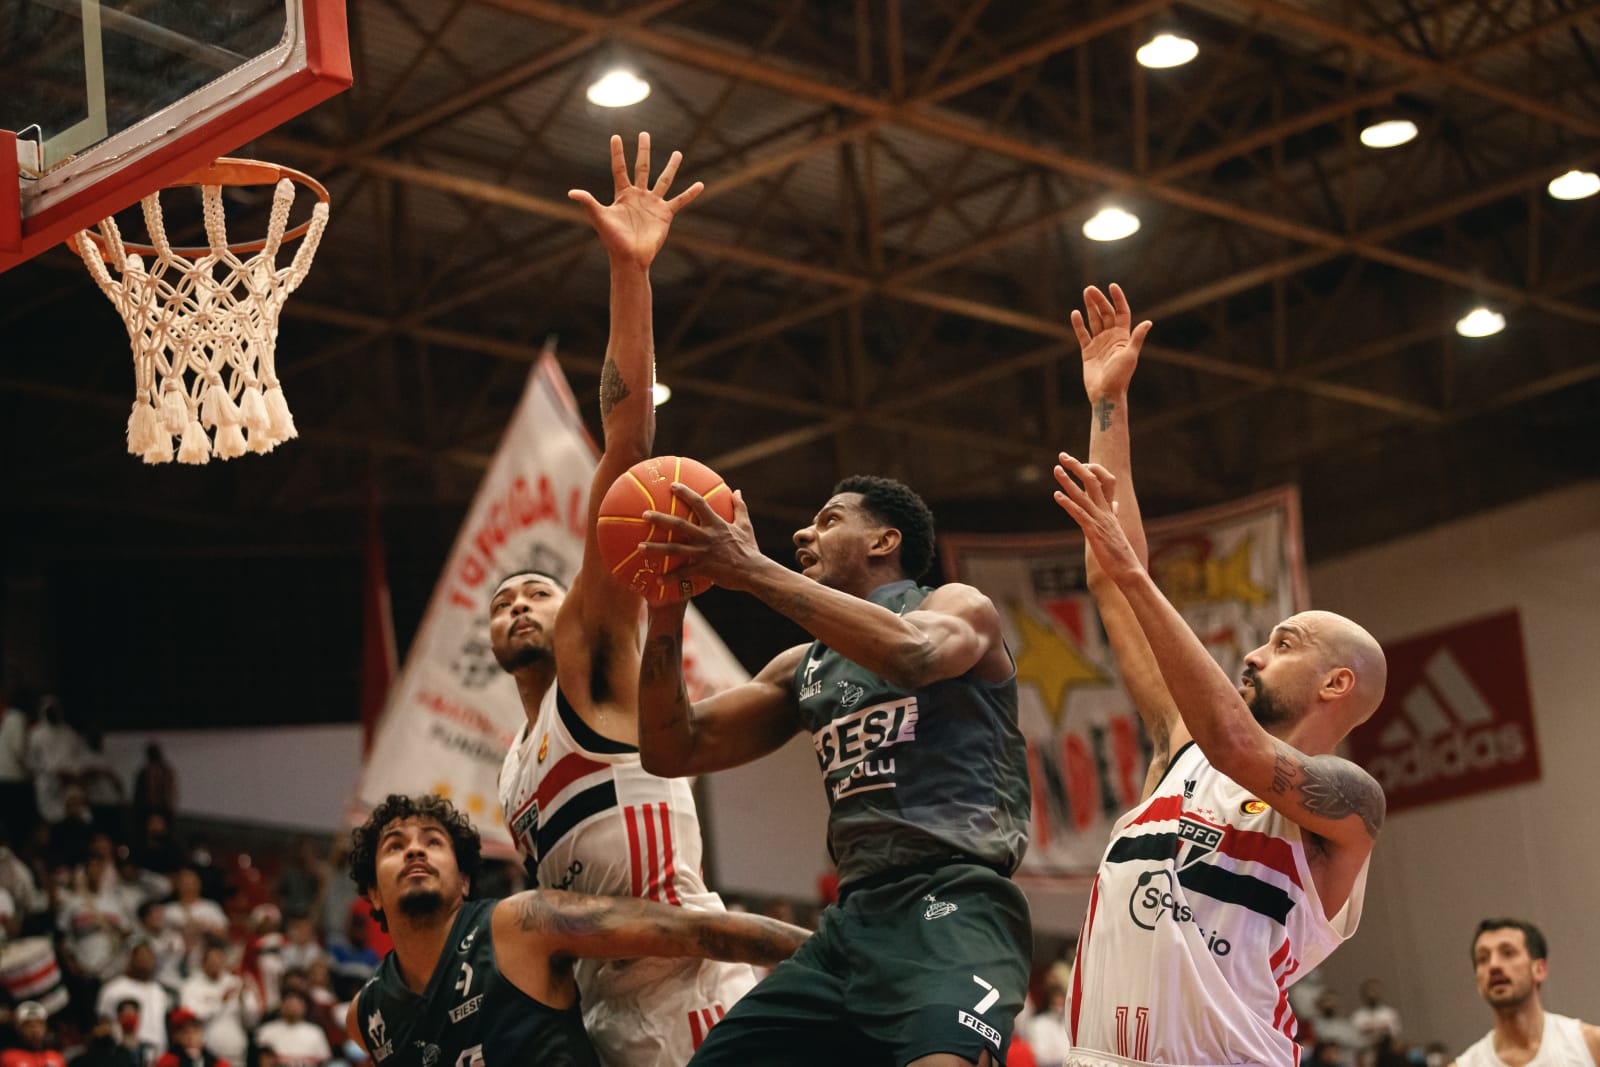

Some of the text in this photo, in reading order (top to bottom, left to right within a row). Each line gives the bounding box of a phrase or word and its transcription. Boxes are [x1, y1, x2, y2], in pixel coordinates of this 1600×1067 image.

[816, 706, 906, 772] SESI
[1178, 822, 1219, 845] SPFC
[972, 974, 1001, 1015] 7
[962, 1014, 1001, 1043] FIESP
[1115, 1006, 1149, 1061] 11
